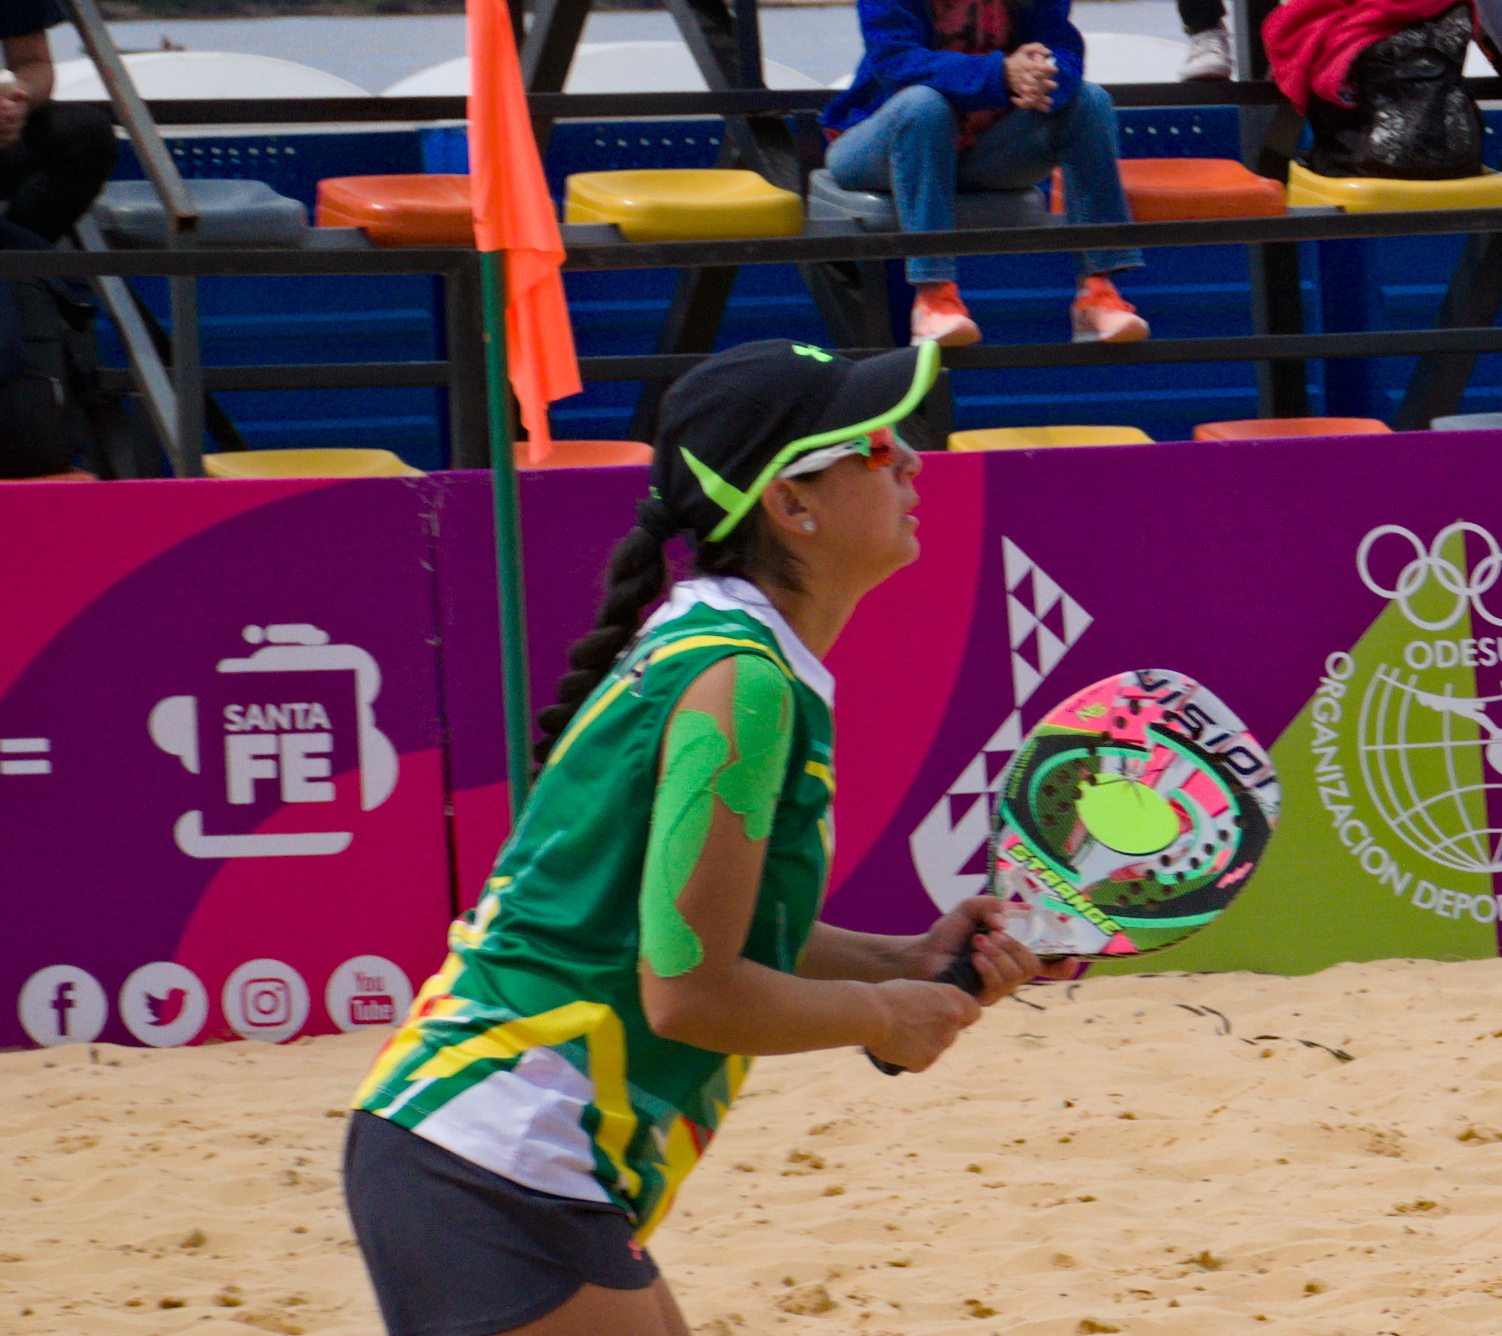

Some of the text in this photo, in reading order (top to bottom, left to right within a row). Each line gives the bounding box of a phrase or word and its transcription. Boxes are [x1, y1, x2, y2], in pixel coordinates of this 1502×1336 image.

[222, 702, 333, 732] SANTA
[222, 732, 338, 805] FE
[1310, 650, 1413, 896] ORGANIZACION
[352, 971, 384, 992] You
[351, 997, 395, 1022] Tube
